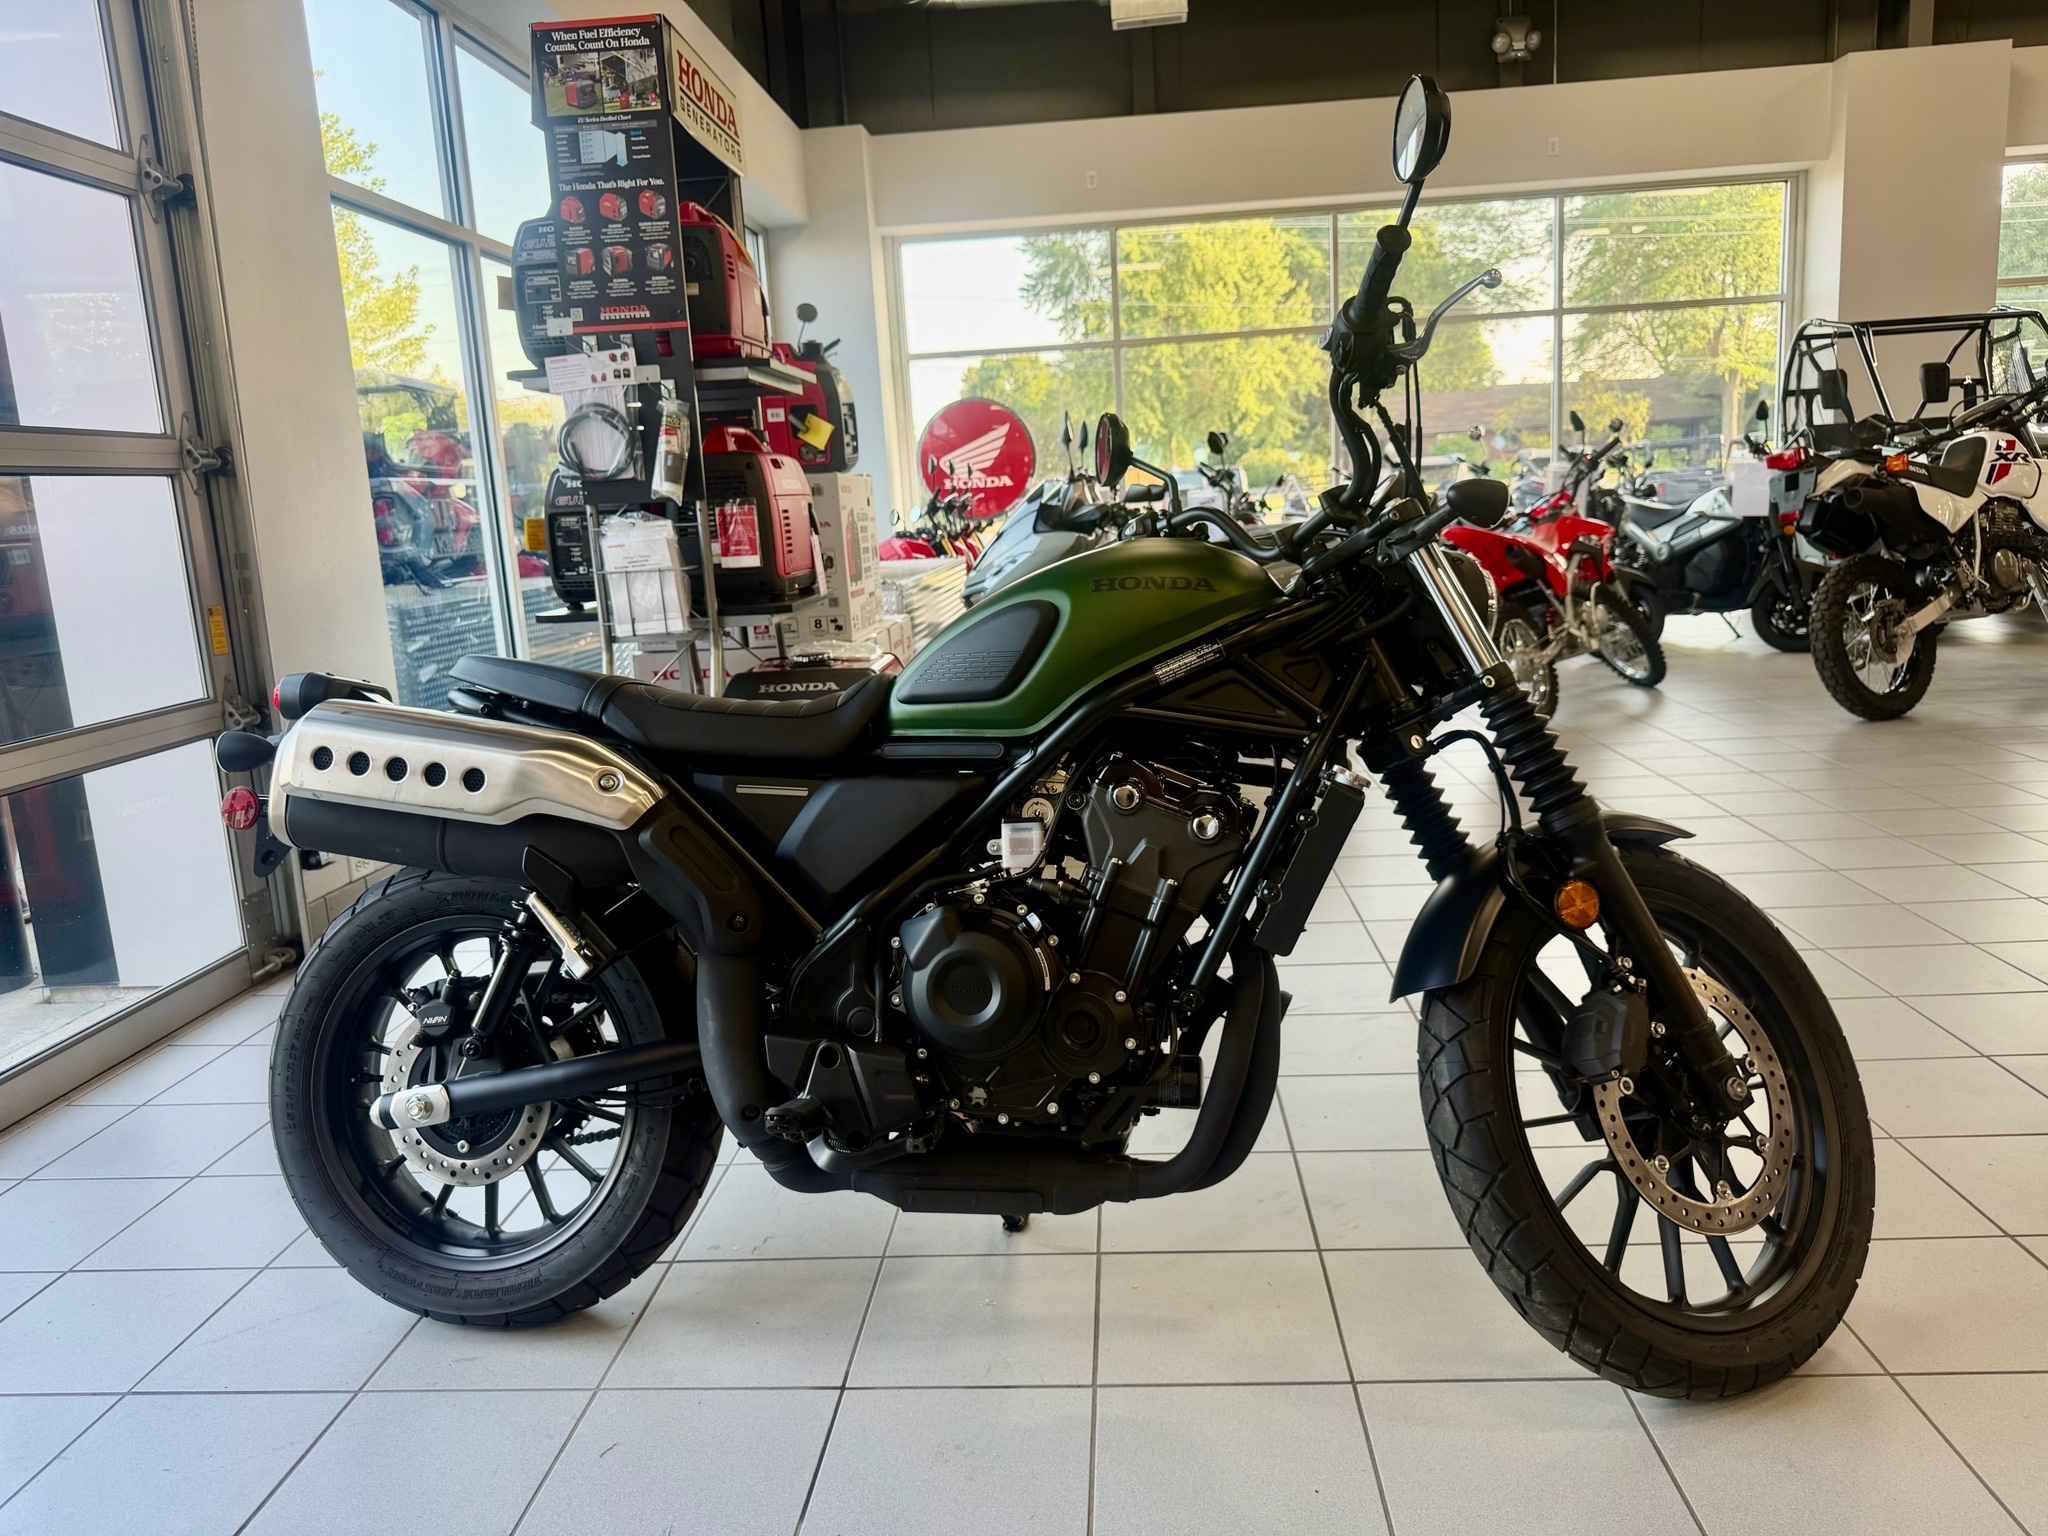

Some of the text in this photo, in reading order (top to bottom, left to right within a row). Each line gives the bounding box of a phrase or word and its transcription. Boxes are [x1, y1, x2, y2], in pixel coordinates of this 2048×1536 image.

[551, 27, 641, 41] When Fuel Efficiency
[544, 36, 650, 52] Counts, Count On Honda
[676, 49, 740, 139] HONDA
[680, 95, 742, 163] GENERATORS
[558, 177, 665, 192] The Honda That's Right For You.
[600, 305, 650, 313] HONDA
[600, 312, 650, 320] GENERATORS
[1988, 452, 2031, 463] XR
[943, 475, 1014, 489] HONDA
[1091, 576, 1218, 592] HONDA
[814, 618, 823, 629] 8
[758, 682, 840, 693] HONDA
[450, 889, 515, 903] DUNLO
[461, 1275, 542, 1301] TRAILMAX
